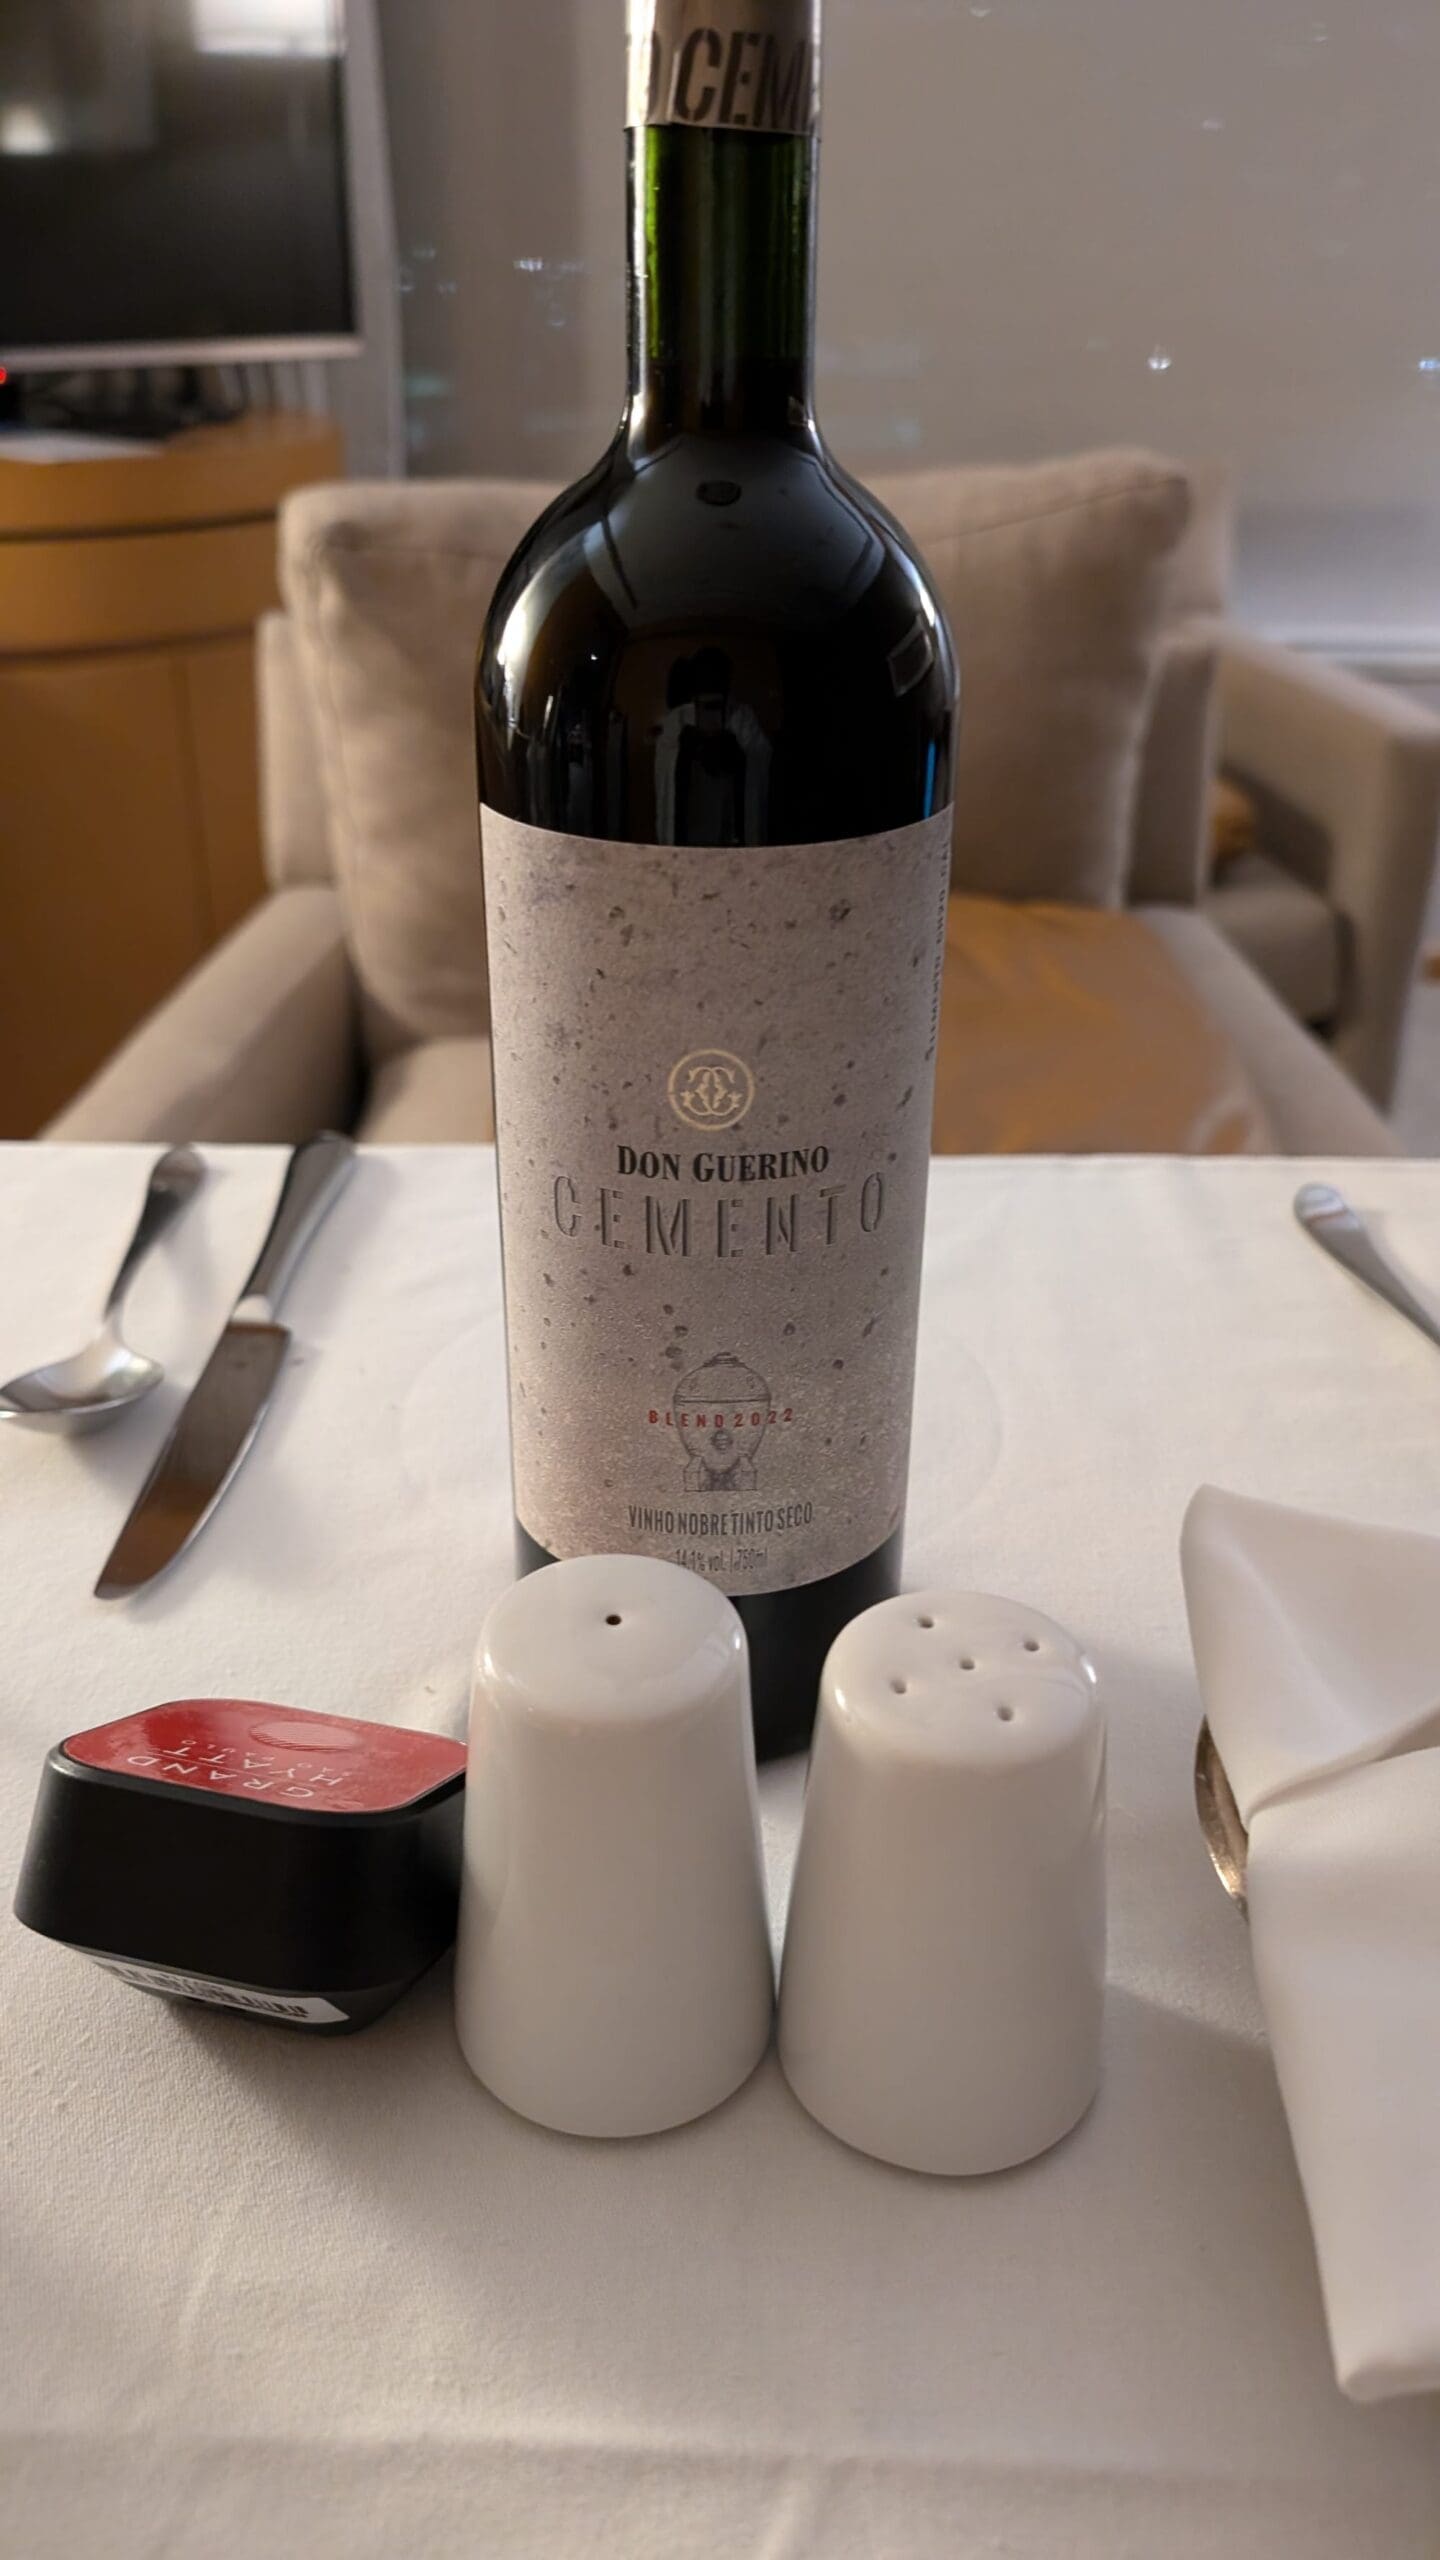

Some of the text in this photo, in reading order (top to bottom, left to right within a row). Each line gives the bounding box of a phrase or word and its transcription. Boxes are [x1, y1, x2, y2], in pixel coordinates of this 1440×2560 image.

[617, 1145, 830, 1182] DON GUERINO
[553, 1172, 885, 1258] CEMENTO
[648, 1408, 794, 1429] BLEND 2022
[628, 1502, 813, 1537] VINHO NOBRE TINTO SECO
[127, 1755, 315, 1798] GRAND
[162, 1746, 344, 1786] HYATT
